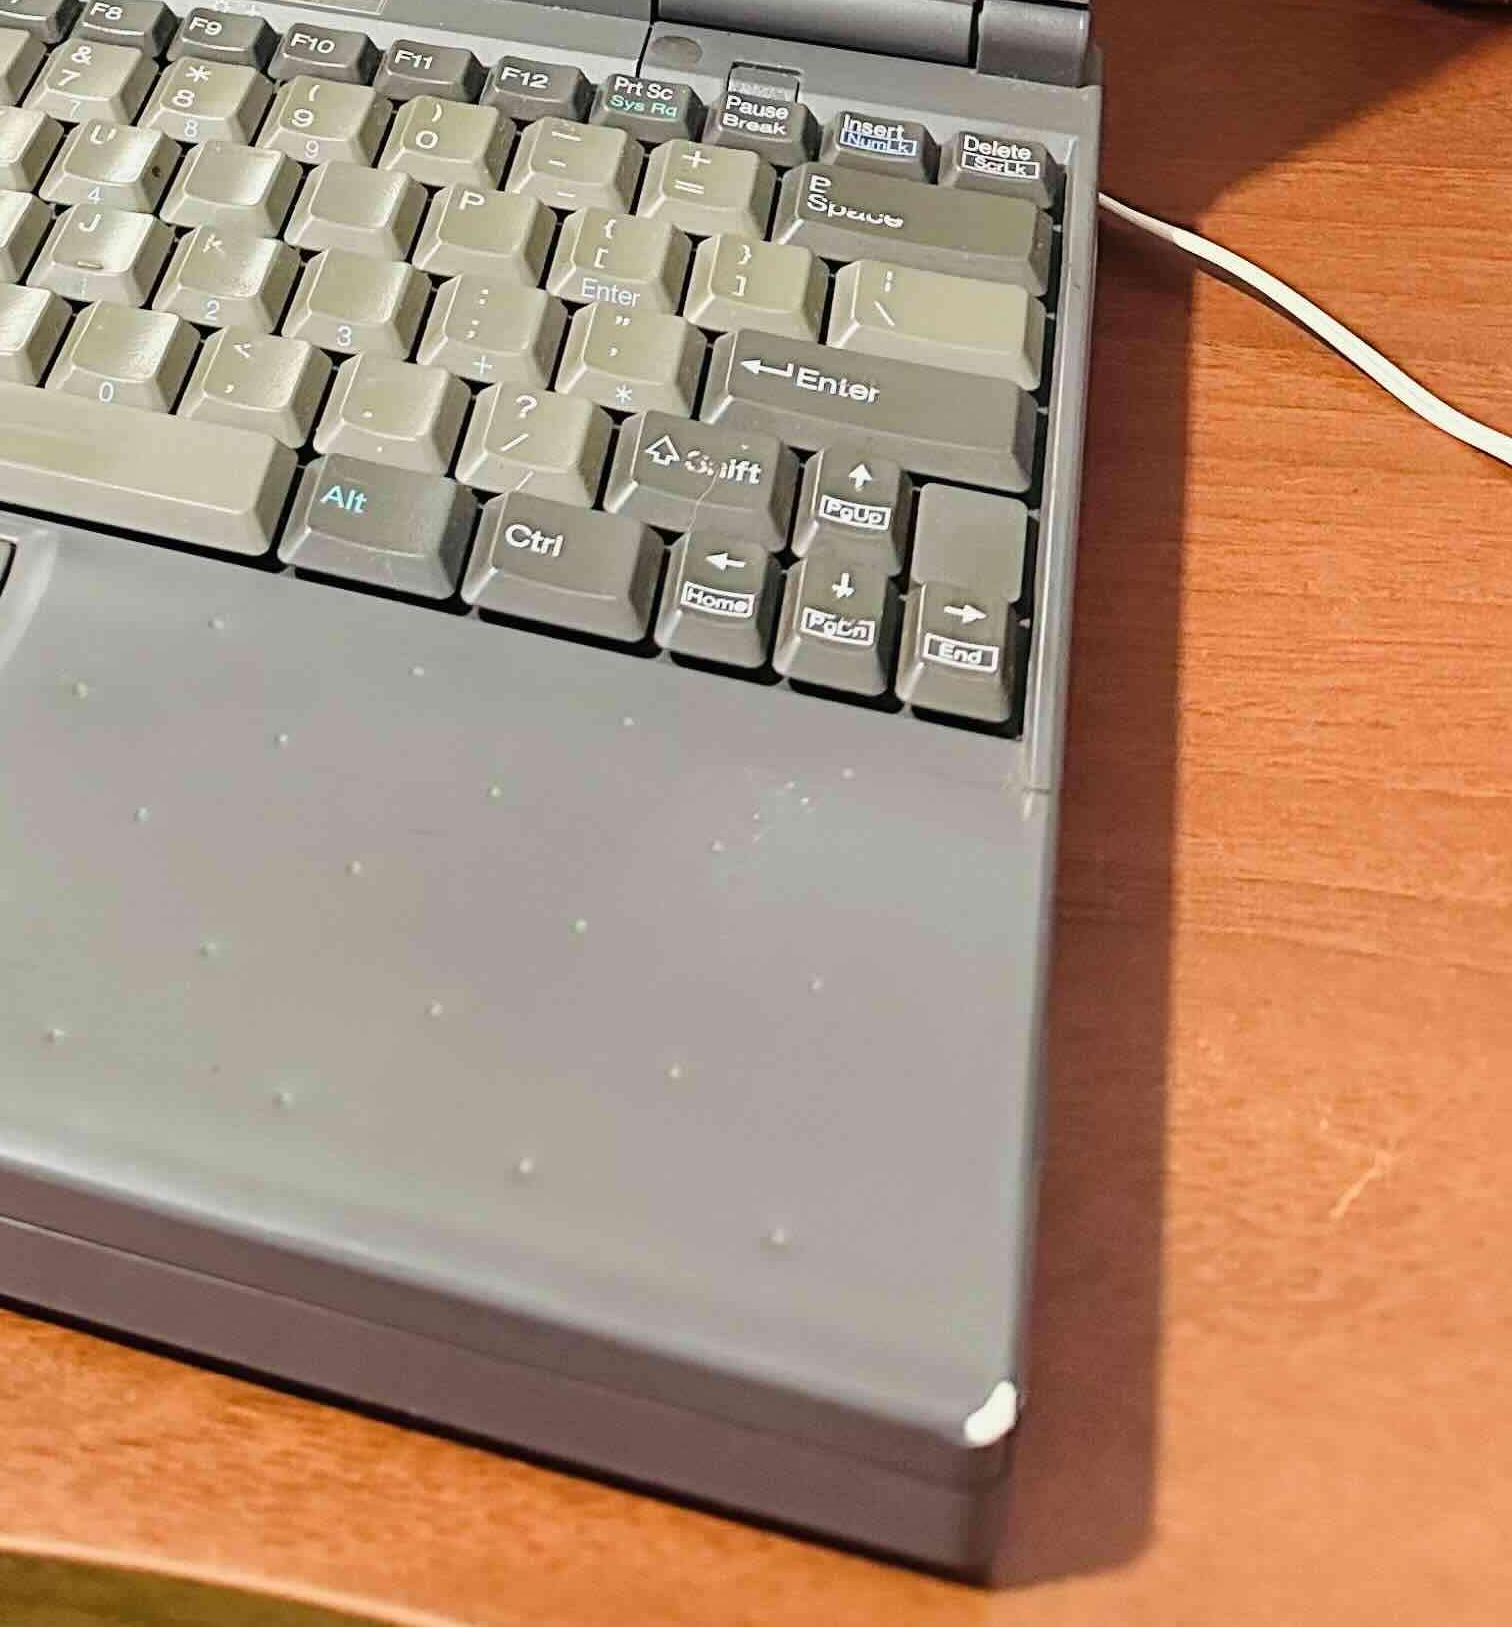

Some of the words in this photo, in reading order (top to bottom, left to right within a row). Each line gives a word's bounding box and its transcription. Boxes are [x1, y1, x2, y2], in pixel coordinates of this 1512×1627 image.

[89, 1, 124, 21] F8
[189, 16, 224, 37] F9
[289, 32, 336, 55] F10
[393, 49, 434, 71] F11
[58, 69, 81, 87] 7
[500, 66, 550, 90] F12
[614, 76, 644, 97] Prt
[646, 83, 674, 101] Sc
[171, 89, 195, 108] 8
[609, 94, 645, 112] Sys
[650, 102, 678, 118] Rq
[725, 95, 789, 120] Pause
[183, 119, 199, 140] 8
[291, 108, 314, 129] 9
[722, 113, 787, 135] Break
[843, 114, 905, 140] Insert
[304, 140, 319, 159] 9
[963, 133, 1033, 161] Delete
[973, 155, 1027, 176] ScrLk
[458, 191, 486, 211] P
[581, 277, 641, 310] Enter
[204, 299, 221, 321] 2
[336, 325, 353, 346] 3
[795, 367, 881, 404] Enter
[320, 484, 368, 515] Alt
[824, 498, 885, 525] PgUp
[503, 524, 565, 558] Ctrl
[686, 586, 750, 613] Home
[938, 642, 983, 665] End
